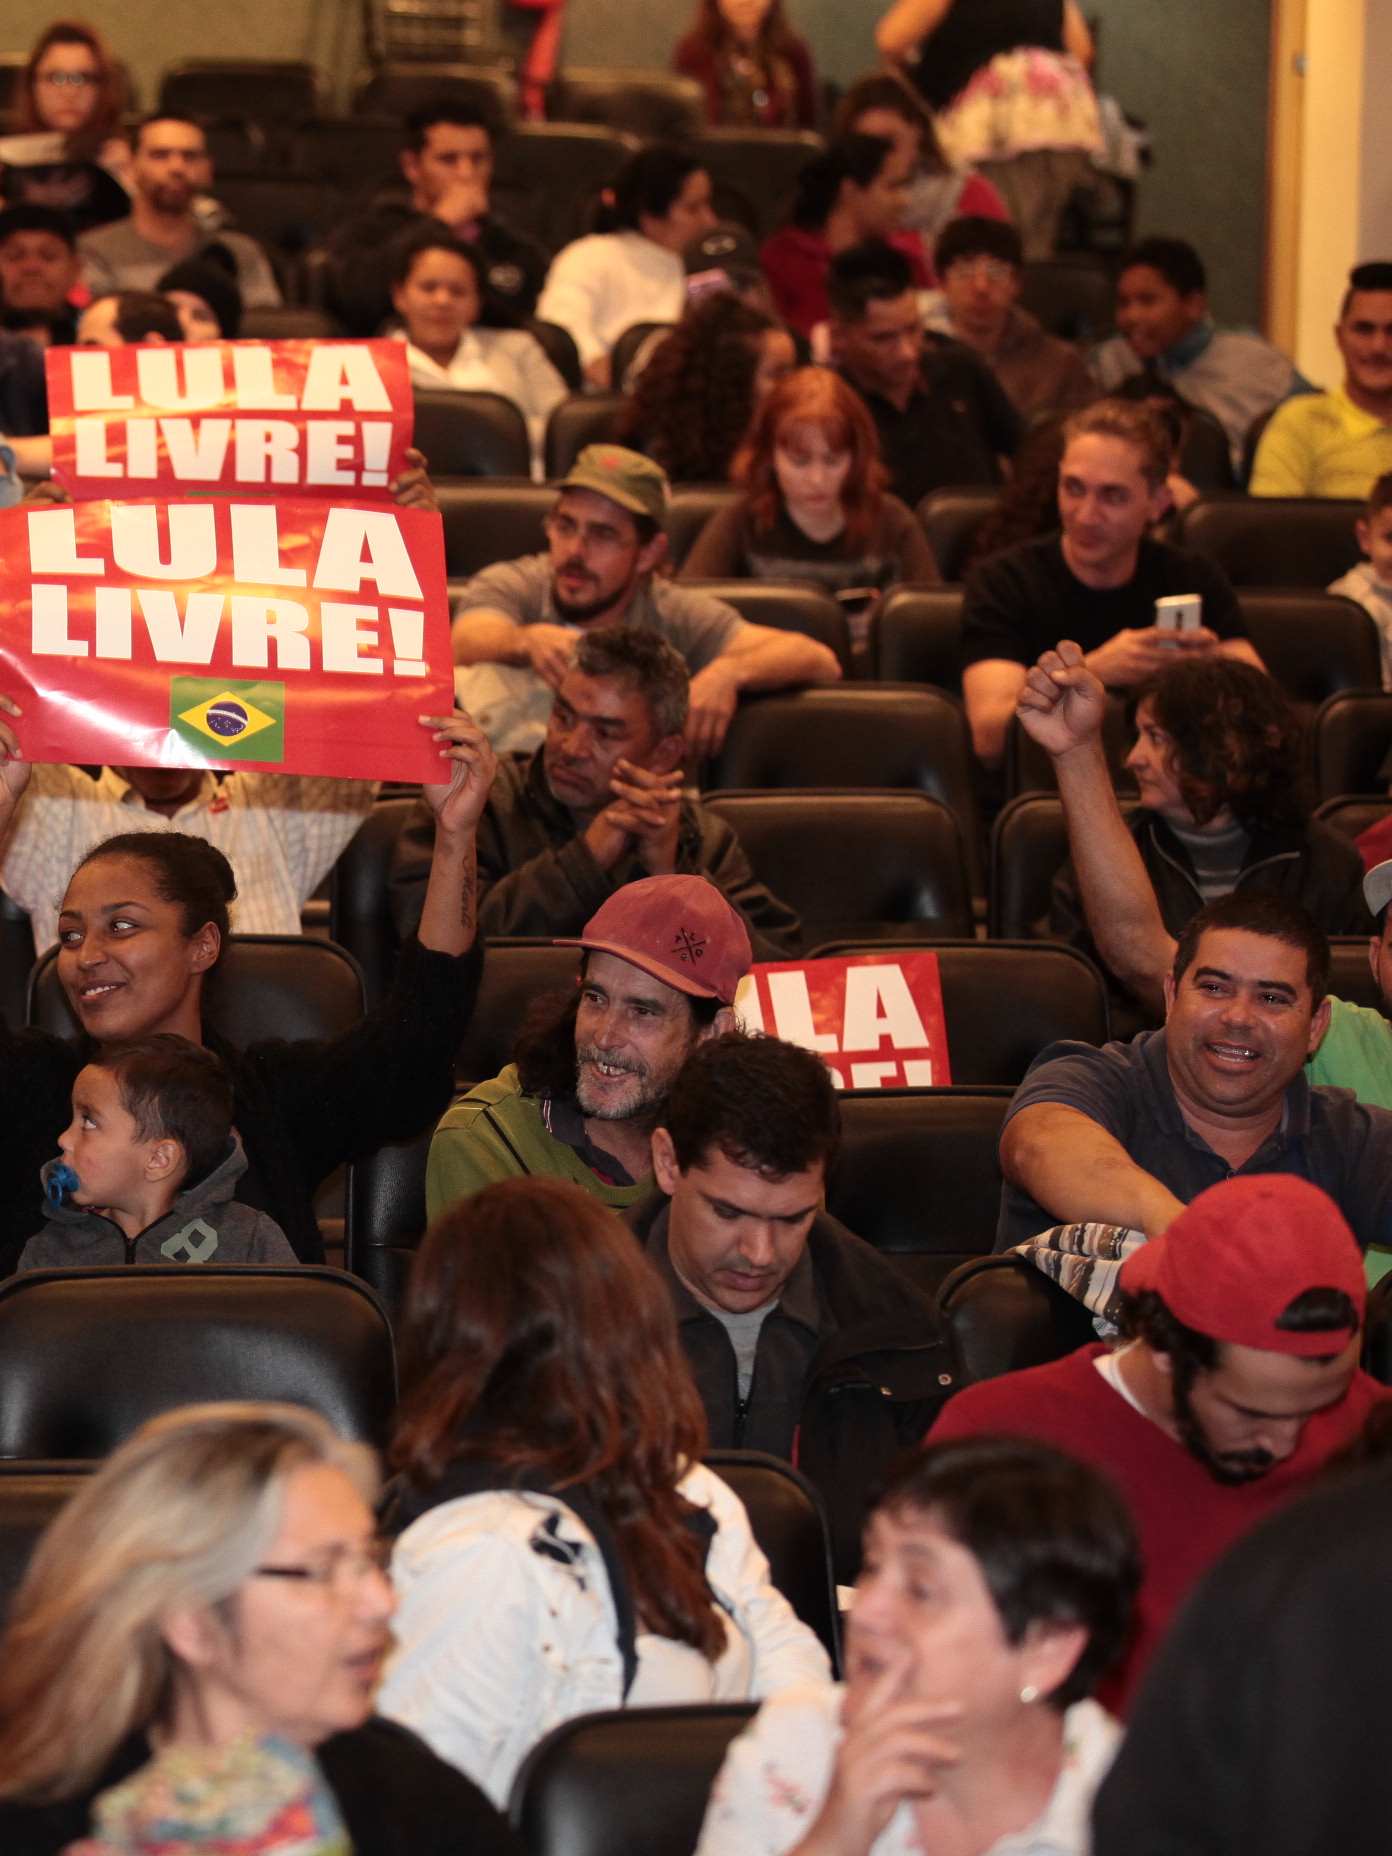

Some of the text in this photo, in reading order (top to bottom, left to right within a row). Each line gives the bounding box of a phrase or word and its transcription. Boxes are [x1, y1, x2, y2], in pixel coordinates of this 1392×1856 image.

[70, 345, 394, 412] LULA
[74, 418, 394, 487] LIVRE!
[27, 503, 425, 600] LULA
[30, 583, 427, 677] LIVRE!
